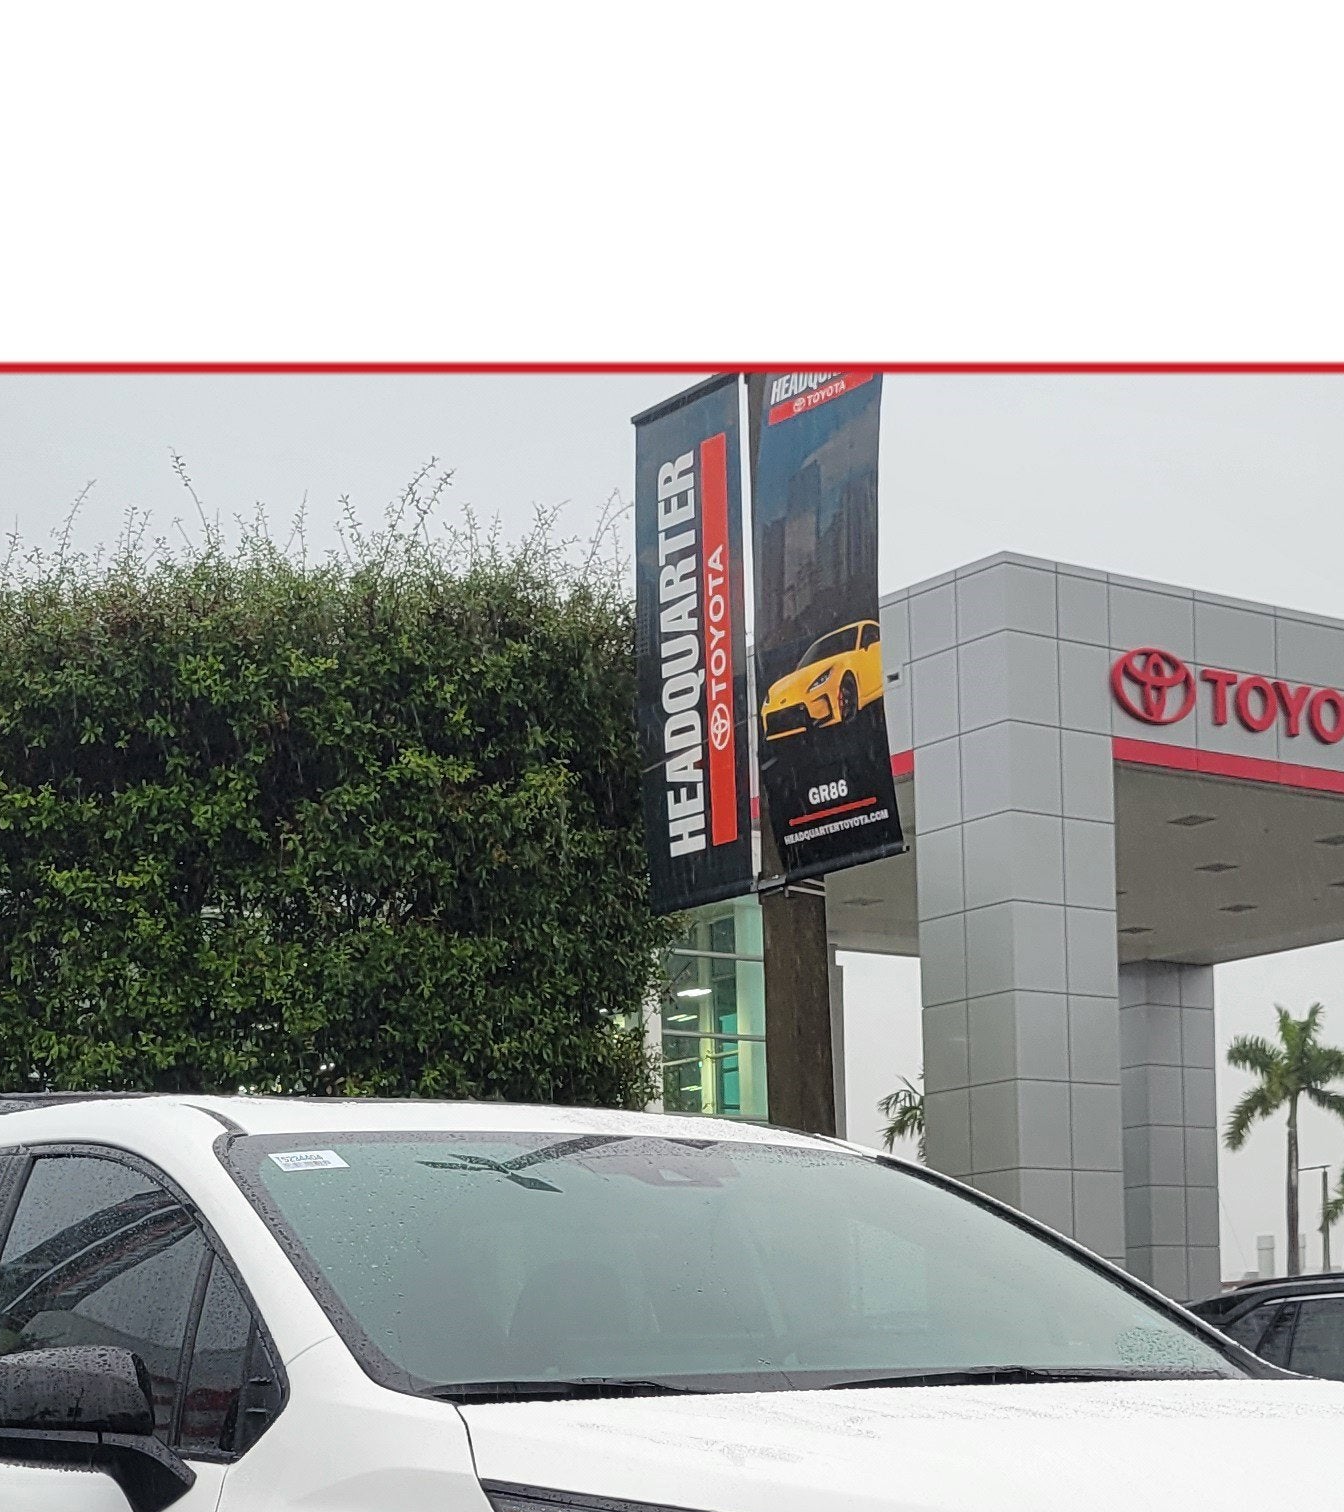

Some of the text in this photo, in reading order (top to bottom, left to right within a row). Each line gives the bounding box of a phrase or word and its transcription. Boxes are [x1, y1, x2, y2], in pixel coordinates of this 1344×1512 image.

[807, 380, 846, 406] TOYOTA
[707, 545, 727, 700] TOYOTA
[657, 450, 706, 857] HEADQUARTER
[808, 779, 848, 805] GR86
[784, 809, 889, 846] HEADQUARTERTOYOTA.COM
